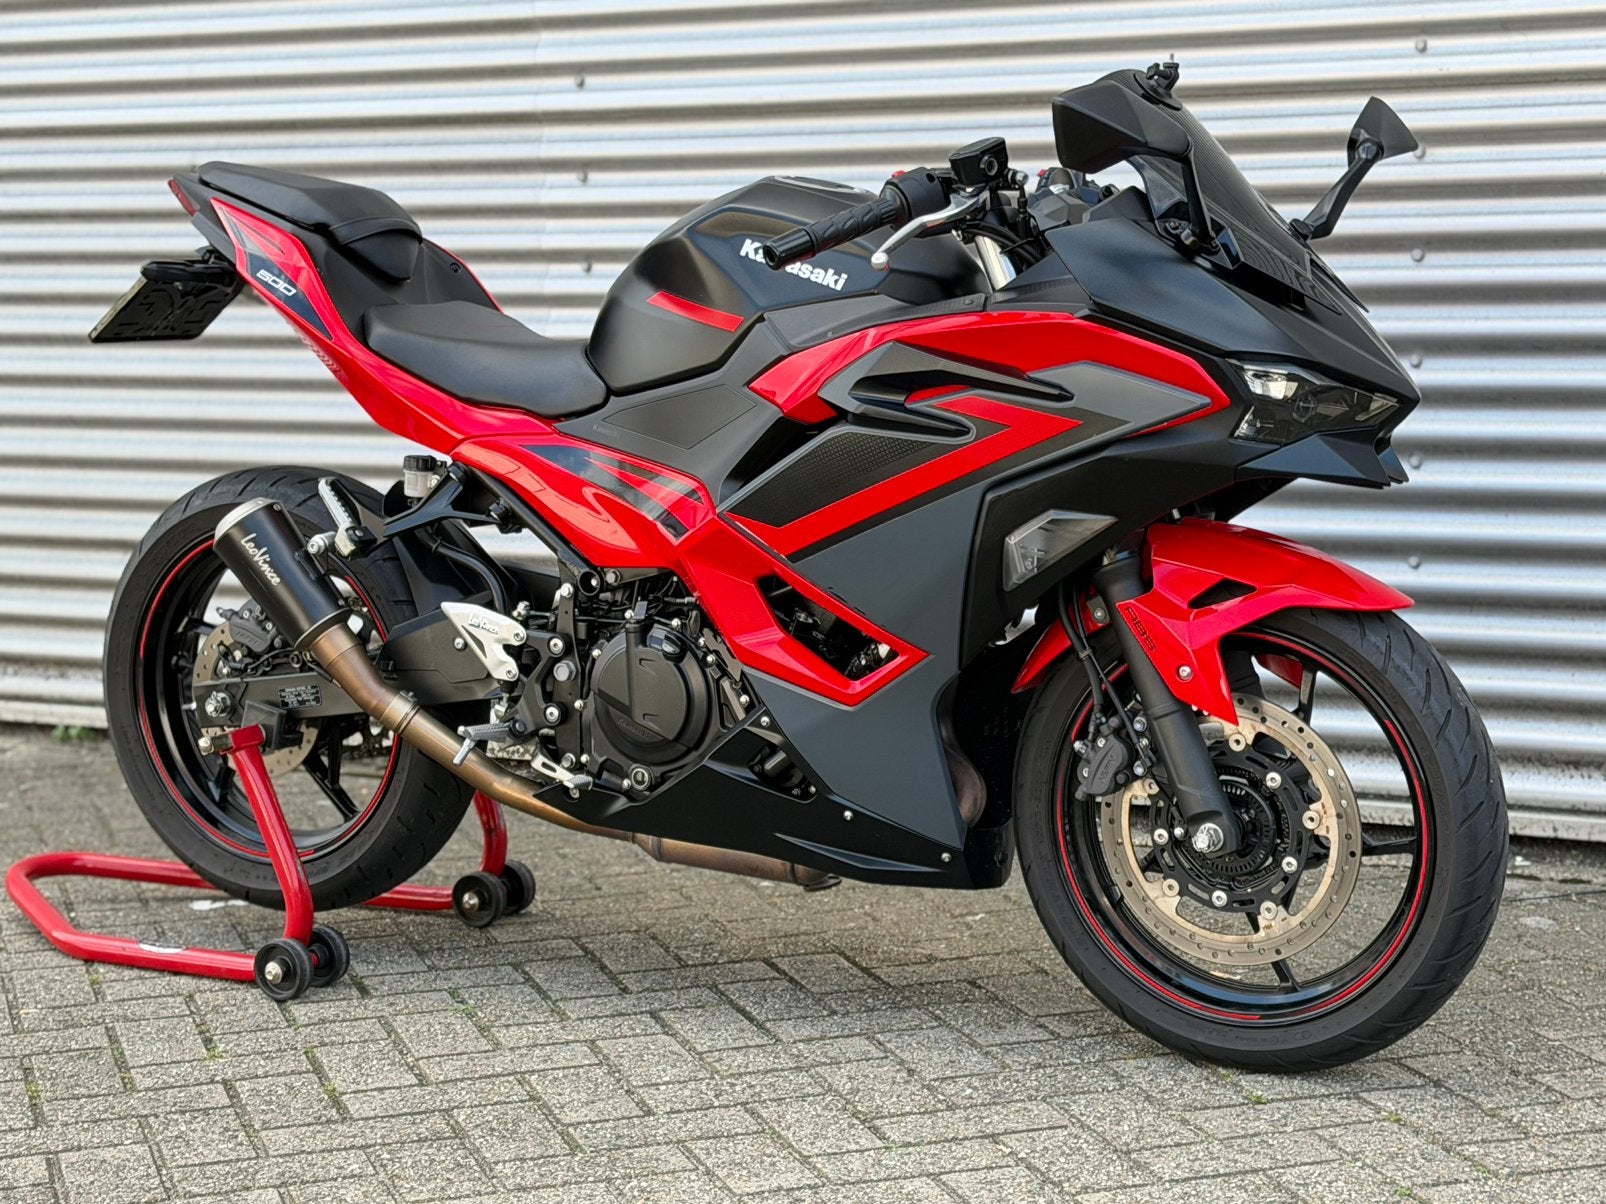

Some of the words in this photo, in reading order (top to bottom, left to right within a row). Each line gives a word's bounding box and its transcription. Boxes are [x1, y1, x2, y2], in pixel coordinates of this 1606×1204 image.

[256, 269, 297, 297] 500
[739, 238, 848, 291] Kaasaki
[240, 533, 281, 586] LeoVince
[1125, 605, 1157, 651] ABS
